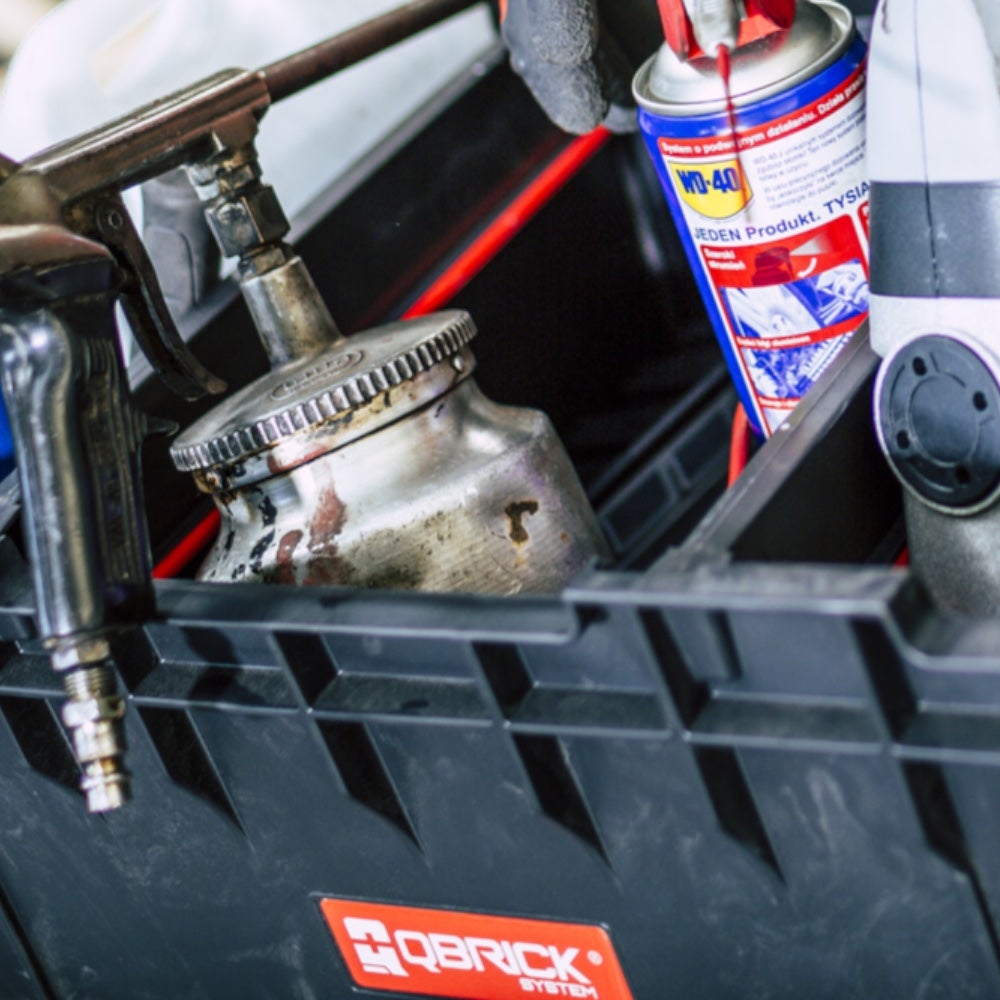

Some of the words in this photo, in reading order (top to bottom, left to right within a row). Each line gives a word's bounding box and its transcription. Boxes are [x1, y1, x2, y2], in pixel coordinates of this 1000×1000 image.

[676, 167, 742, 195] WD-40
[694, 227, 742, 242] JEDEN
[745, 210, 820, 240] Produkt.
[394, 929, 592, 985] QBRICK
[519, 977, 599, 999] SYSTEM
